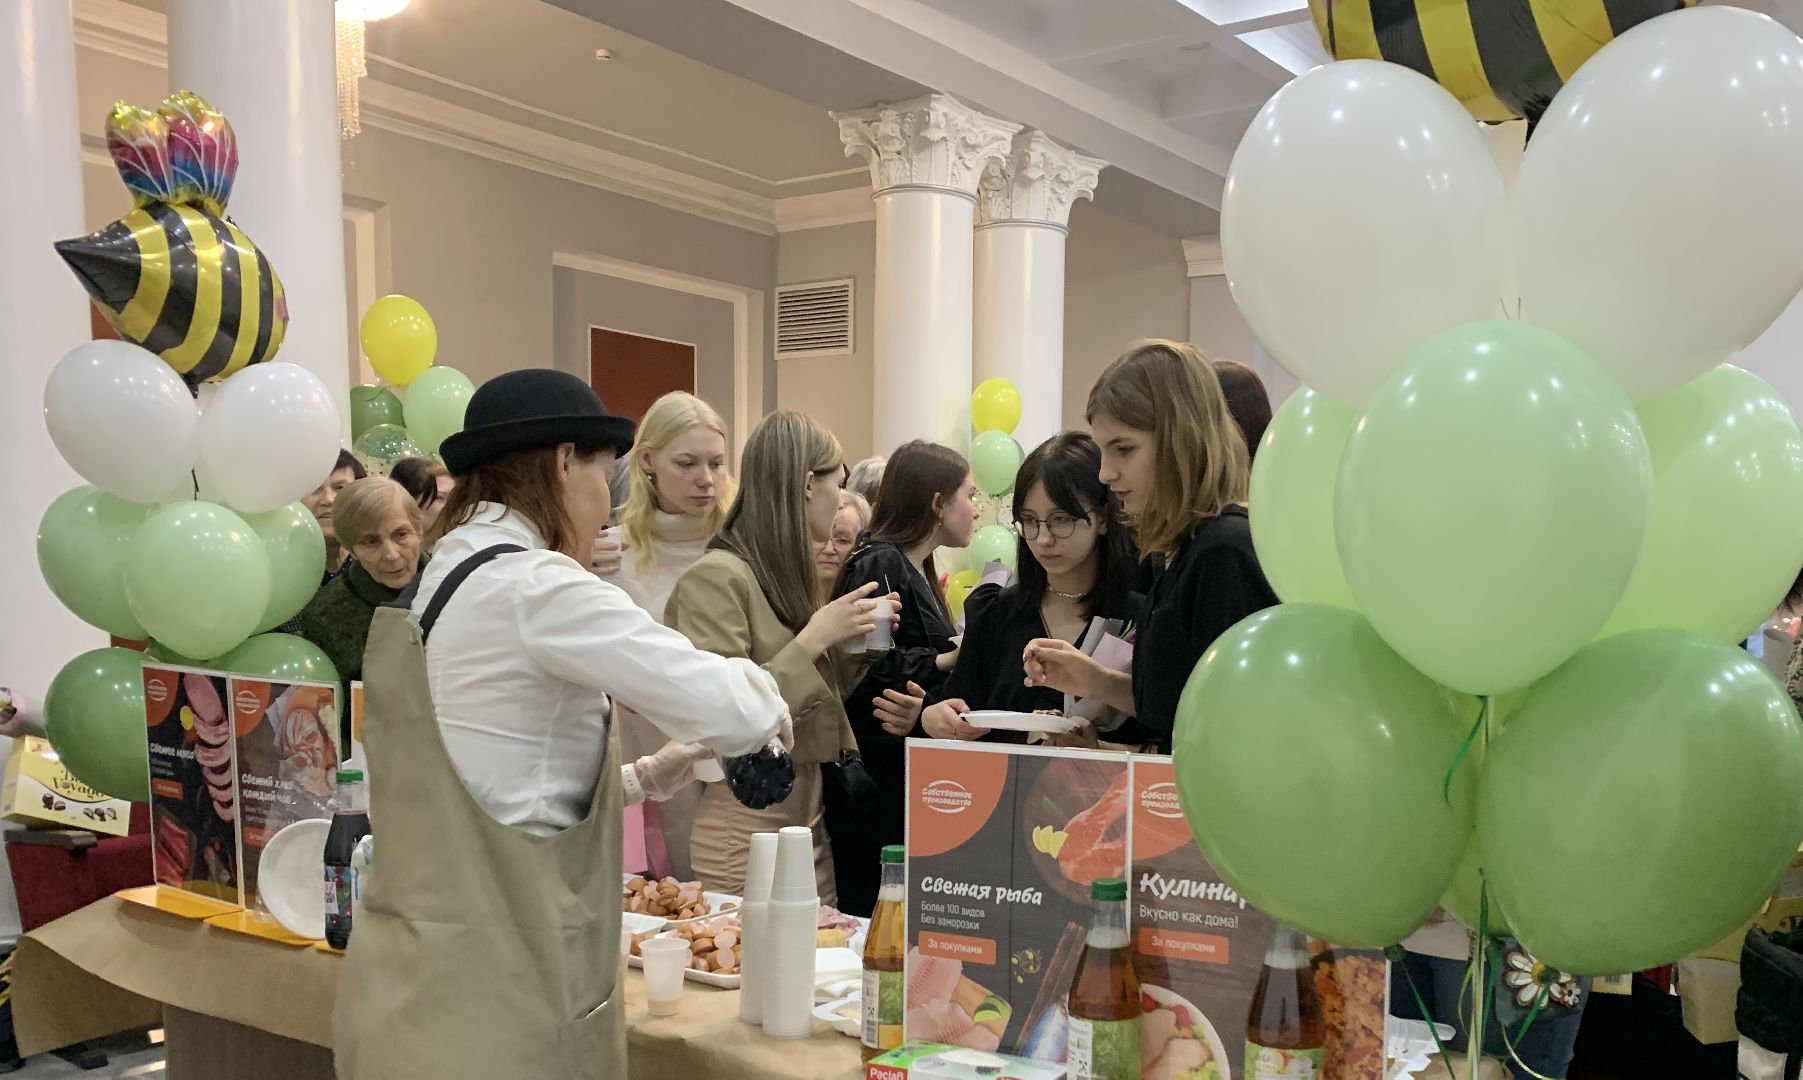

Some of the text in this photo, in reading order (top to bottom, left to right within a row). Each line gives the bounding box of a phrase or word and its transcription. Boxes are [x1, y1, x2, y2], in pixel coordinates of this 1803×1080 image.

[922, 787, 972, 799] Собственное
[1141, 790, 1178, 801] Собстве
[921, 876, 1043, 905] Свежая рыба
[921, 901, 985, 918] Более 100 видов
[1140, 904, 1239, 929] Вкусно как дома!
[920, 913, 980, 930] Без заморозки
[928, 938, 982, 955] За покупками
[1151, 935, 1215, 953] За покупками
